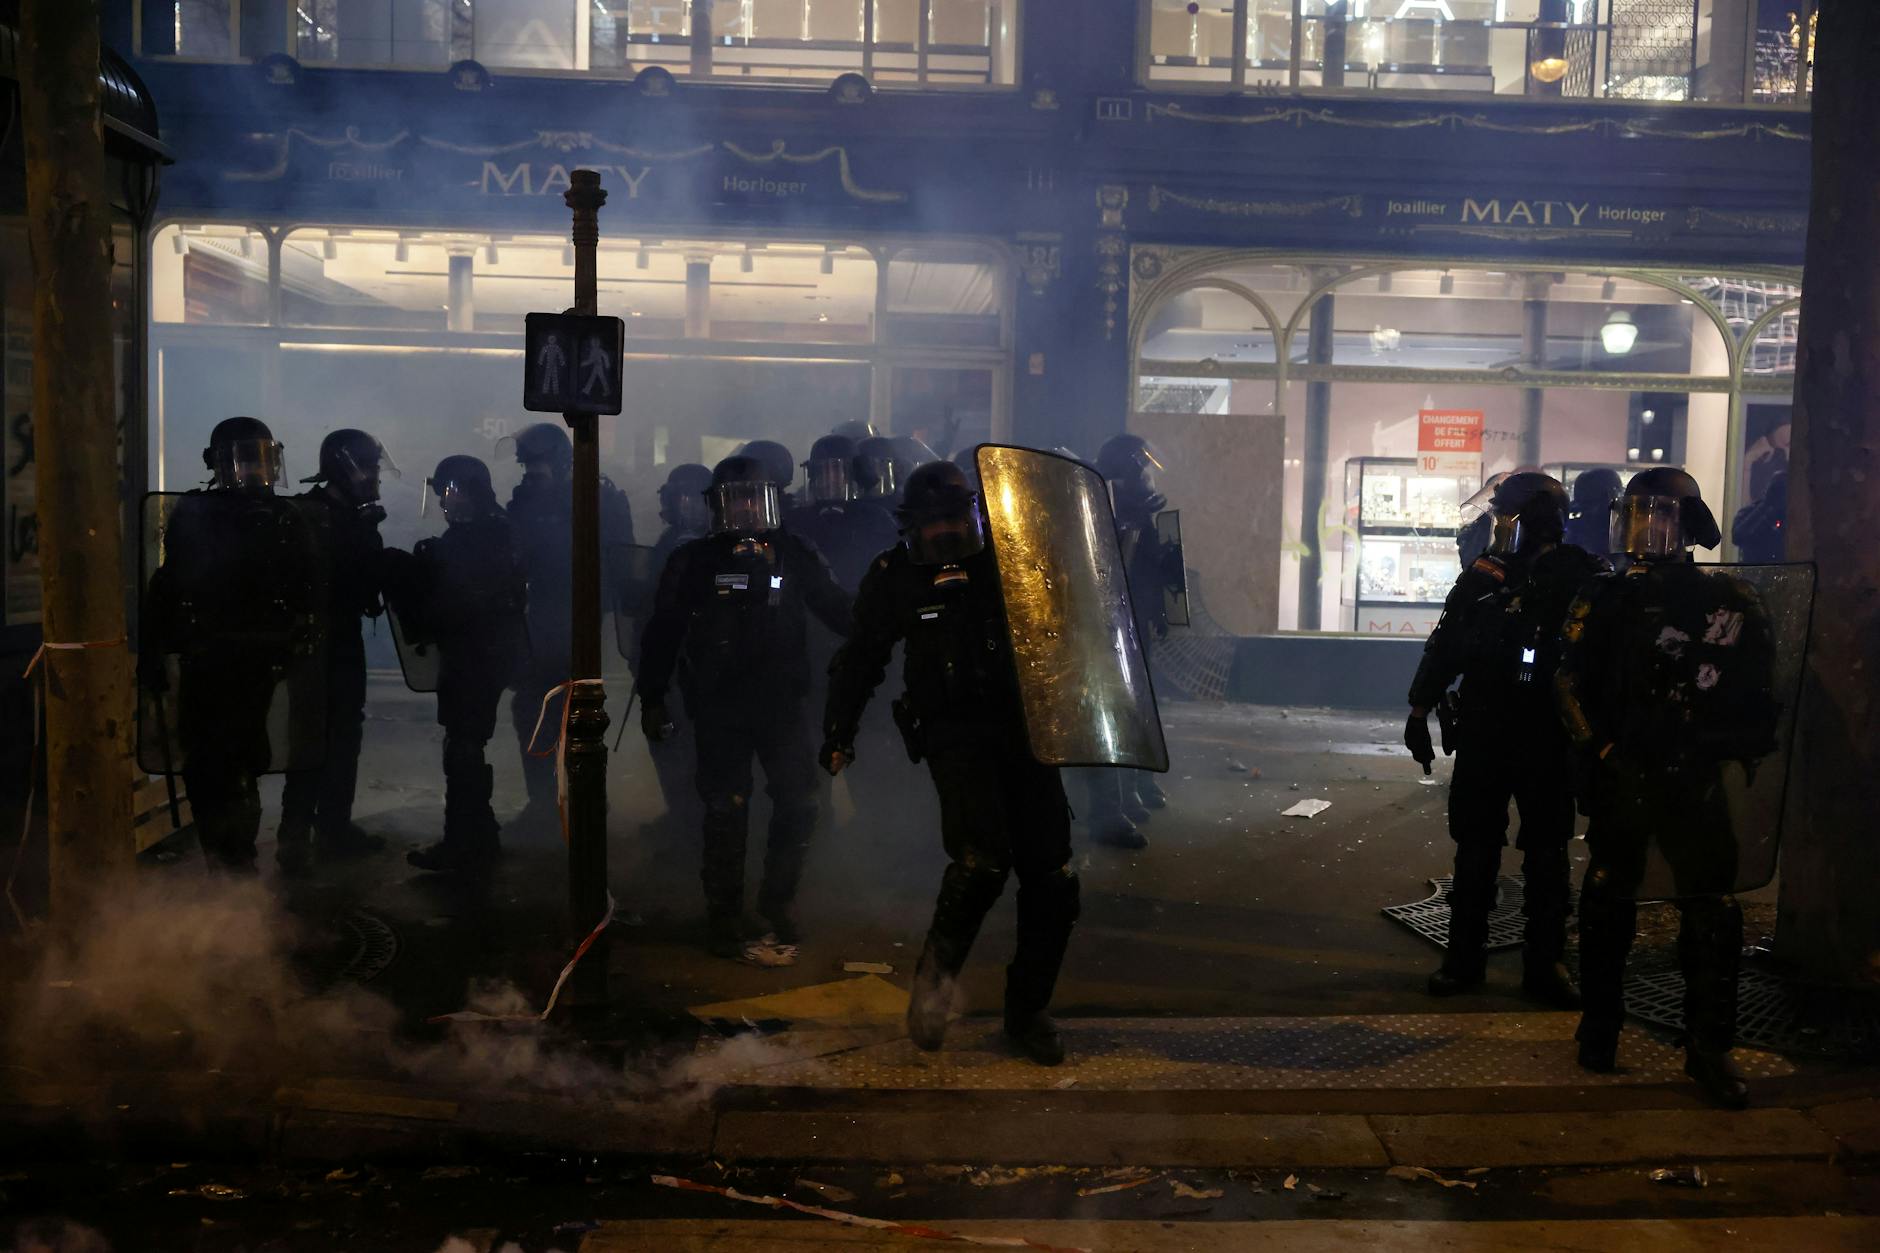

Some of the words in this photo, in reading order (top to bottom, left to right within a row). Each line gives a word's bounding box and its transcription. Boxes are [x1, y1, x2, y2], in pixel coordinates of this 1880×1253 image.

[723, 175, 808, 197] Horloger
[1387, 199, 1447, 215] Joaillier
[1460, 198, 1590, 226] MATY
[1599, 205, 1667, 224] Horloger
[1423, 415, 1479, 425] CHANGEMENT
[1434, 427, 1447, 436] DE
[1434, 438, 1466, 448] OFFERT
[1369, 620, 1437, 634] MAT
